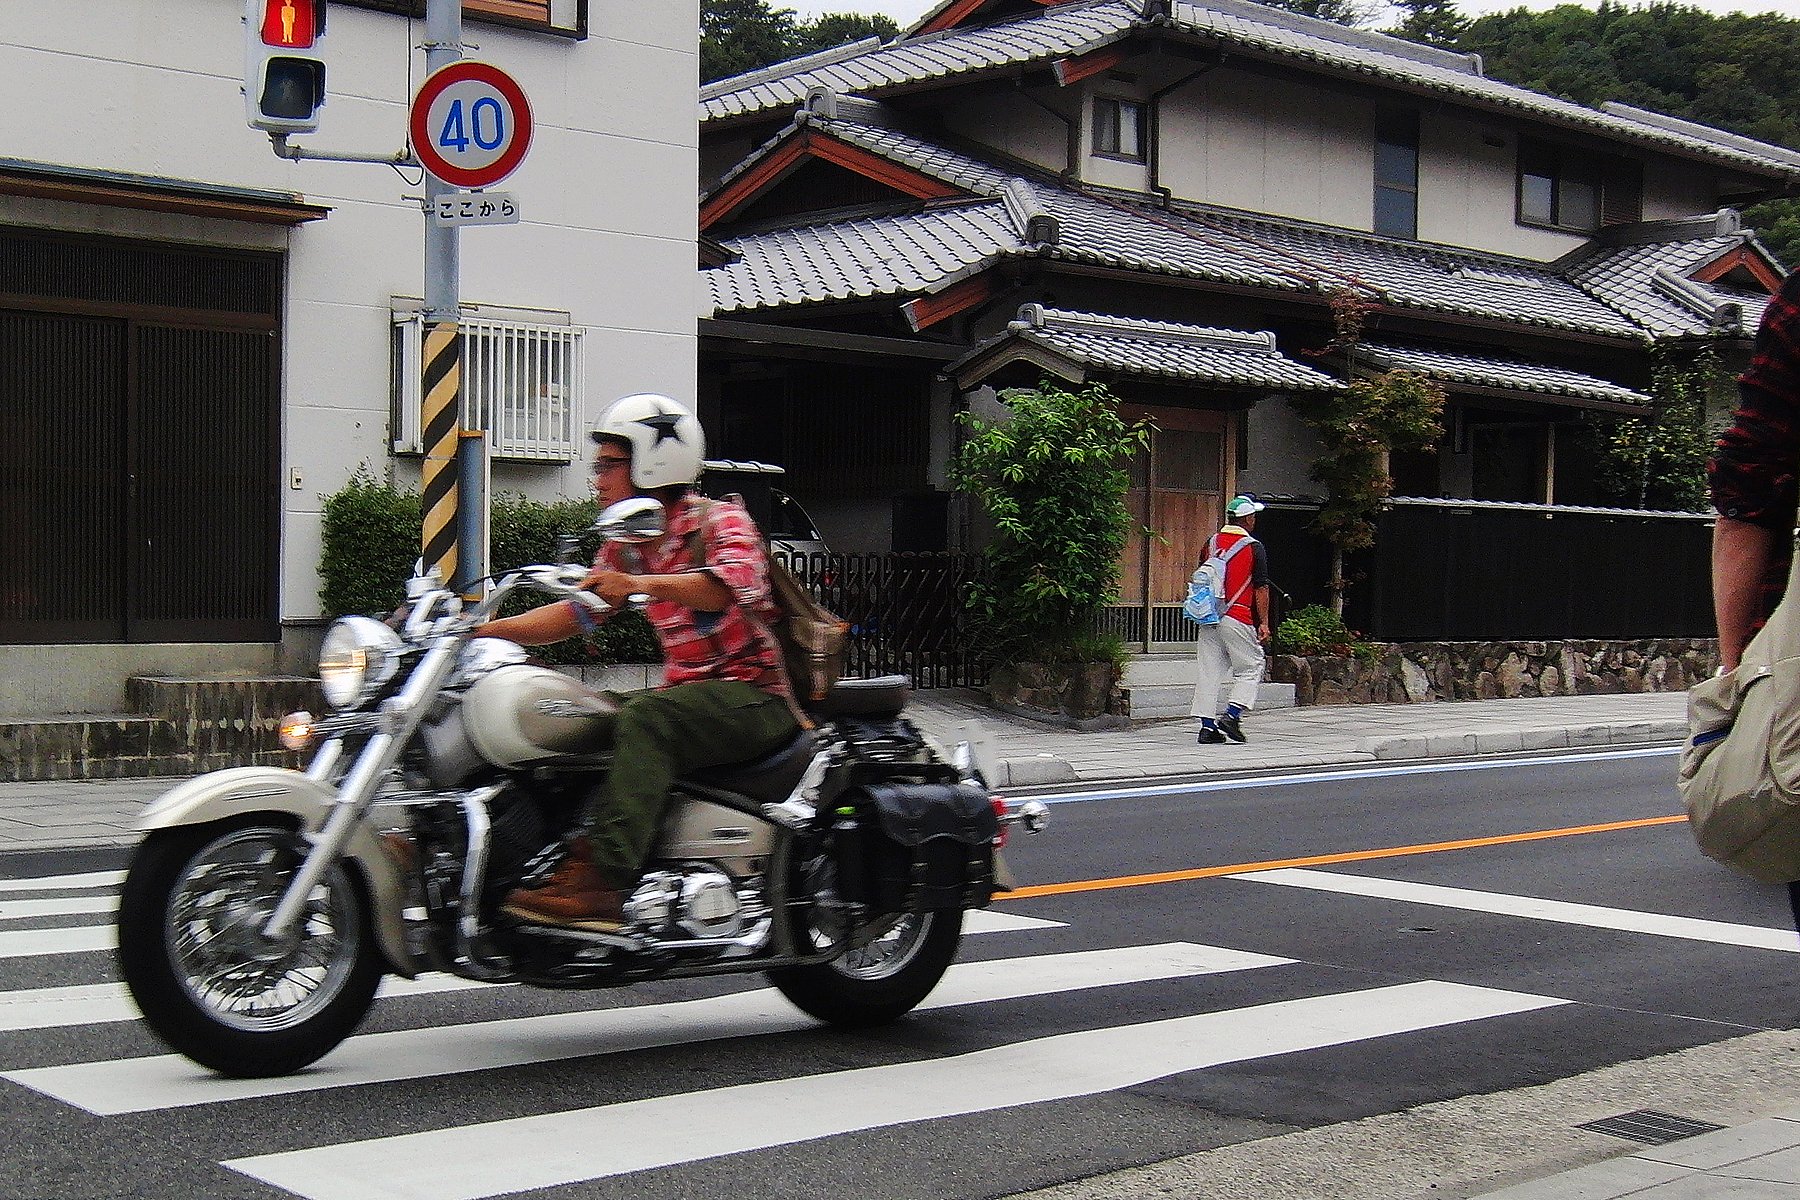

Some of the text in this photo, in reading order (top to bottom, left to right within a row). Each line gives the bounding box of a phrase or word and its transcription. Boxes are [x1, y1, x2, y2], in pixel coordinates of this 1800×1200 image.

[439, 97, 504, 152] 40
[440, 200, 515, 219] ここから
